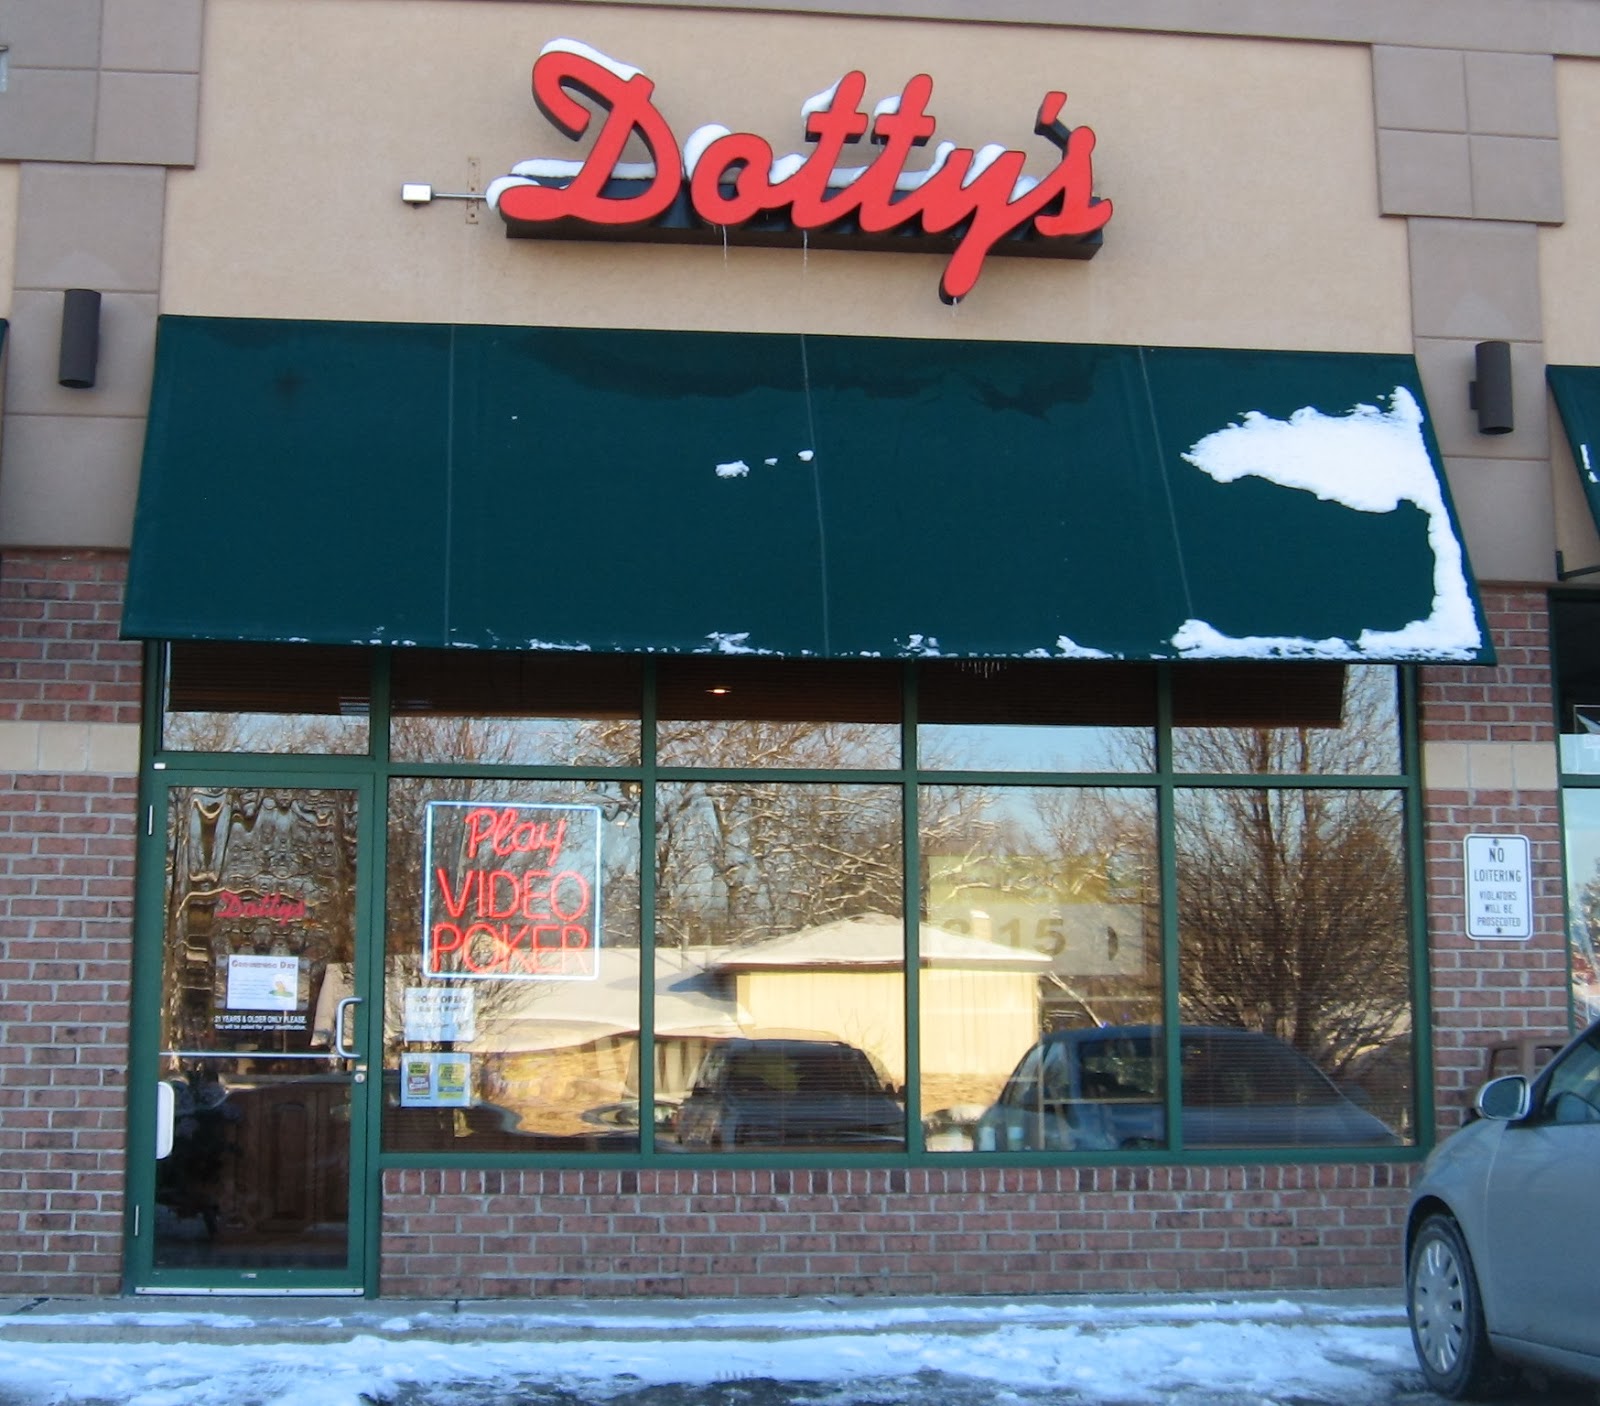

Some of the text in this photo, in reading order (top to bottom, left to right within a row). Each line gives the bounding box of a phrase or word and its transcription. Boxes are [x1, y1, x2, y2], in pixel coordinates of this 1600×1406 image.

[499, 50, 1113, 299] Dotty's
[465, 807, 567, 867] Play
[1489, 847, 1505, 863] NO
[1473, 868, 1522, 883] LOITERING
[435, 867, 590, 922] VIDEO
[1479, 890, 1518, 901] VIOLATORS
[214, 889, 306, 927] Dotty's
[1484, 904, 1513, 914] WILL BE
[1477, 916, 1521, 928] PROSECUTED
[431, 921, 590, 974] POKER
[222, 1015, 241, 1023] YEARS
[247, 1015, 266, 1023] OLDER
[267, 1015, 283, 1023] ONLY
